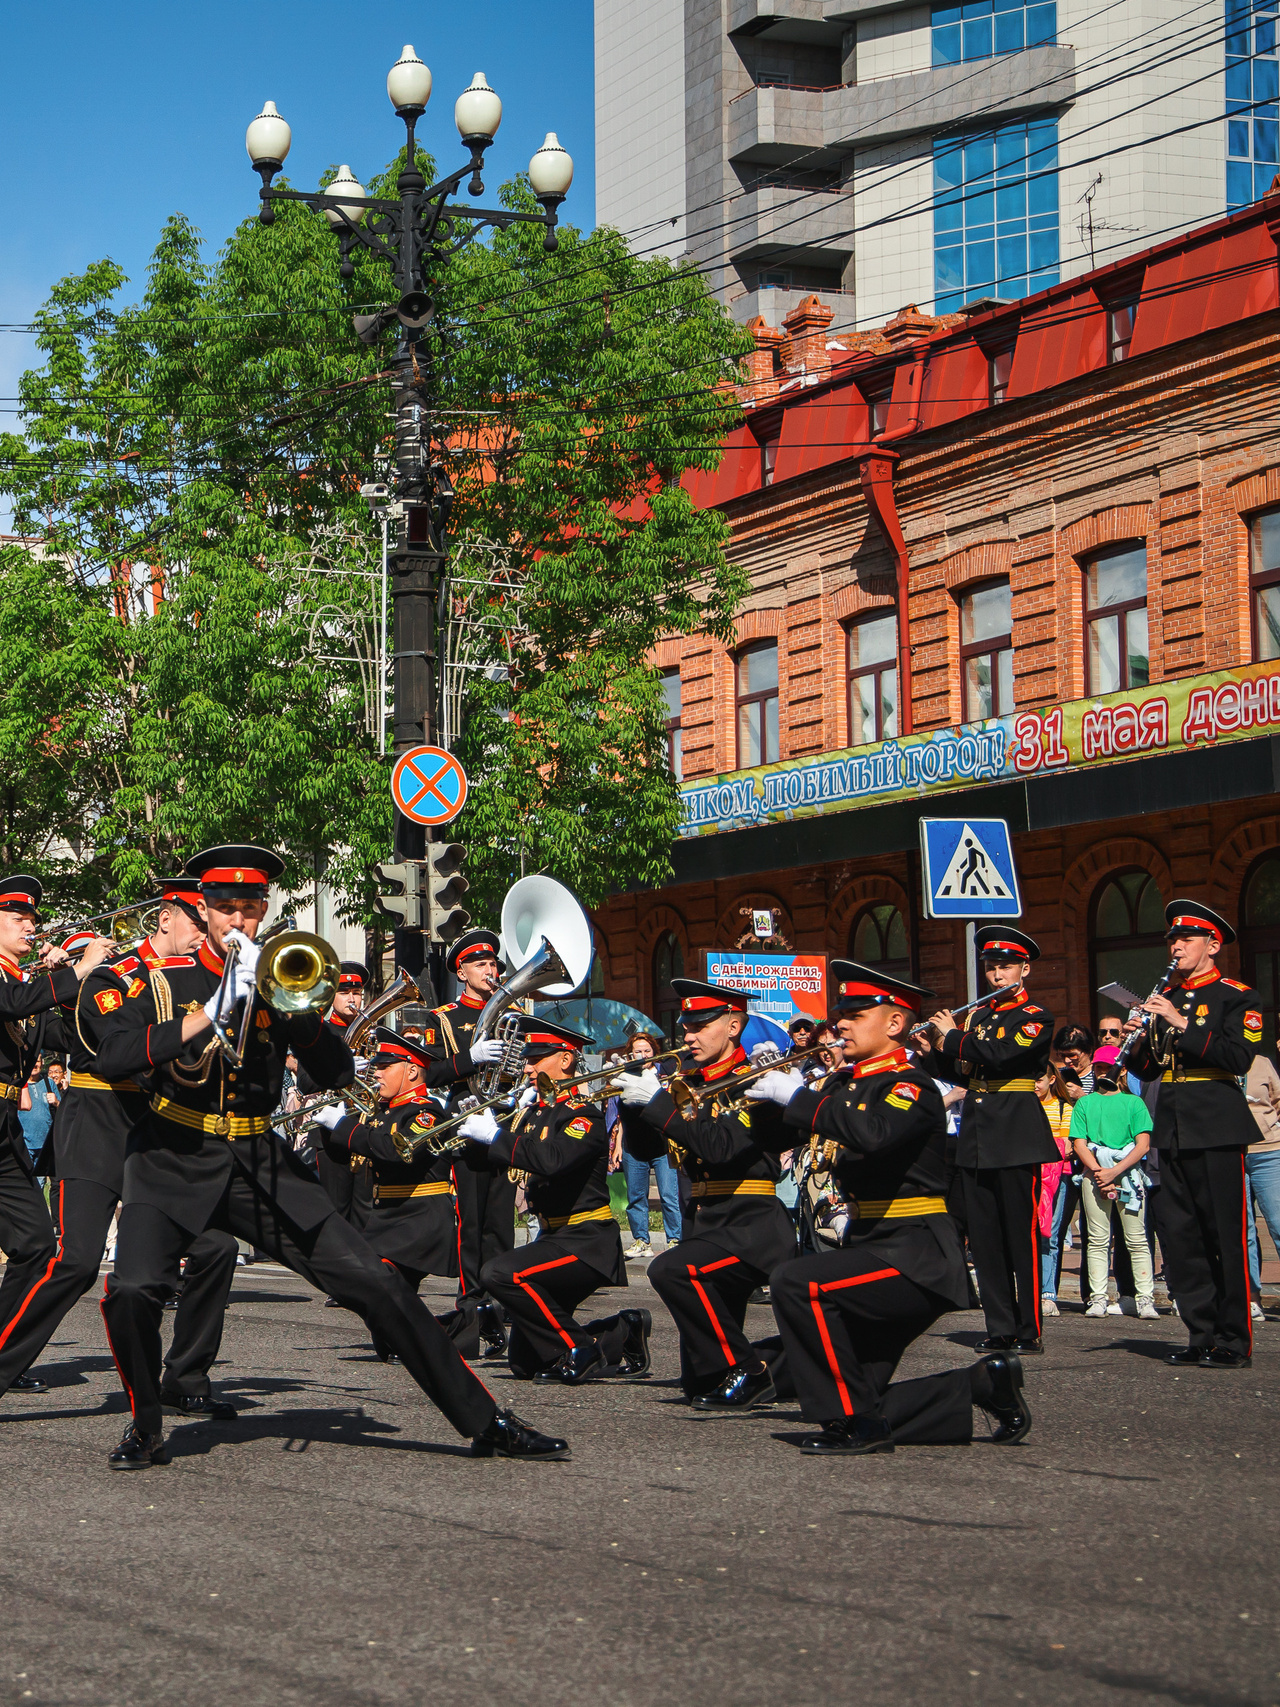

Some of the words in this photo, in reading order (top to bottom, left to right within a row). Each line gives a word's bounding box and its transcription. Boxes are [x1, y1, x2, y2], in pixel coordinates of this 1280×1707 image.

[1015, 707, 1069, 773] 31
[1083, 698, 1168, 760] мая
[677, 777, 760, 828] ИКОМ,
[760, 741, 903, 812] ЛЮБИМЫЙ
[905, 727, 1005, 786] ГОРОД!
[711, 964, 720, 974] С
[721, 963, 753, 976] ДНЁМ
[755, 966, 822, 979] РОЖДЕНИЯ,
[716, 977, 777, 990] ЛЮБИМЫЙ
[780, 980, 821, 992] ГОРОД!
